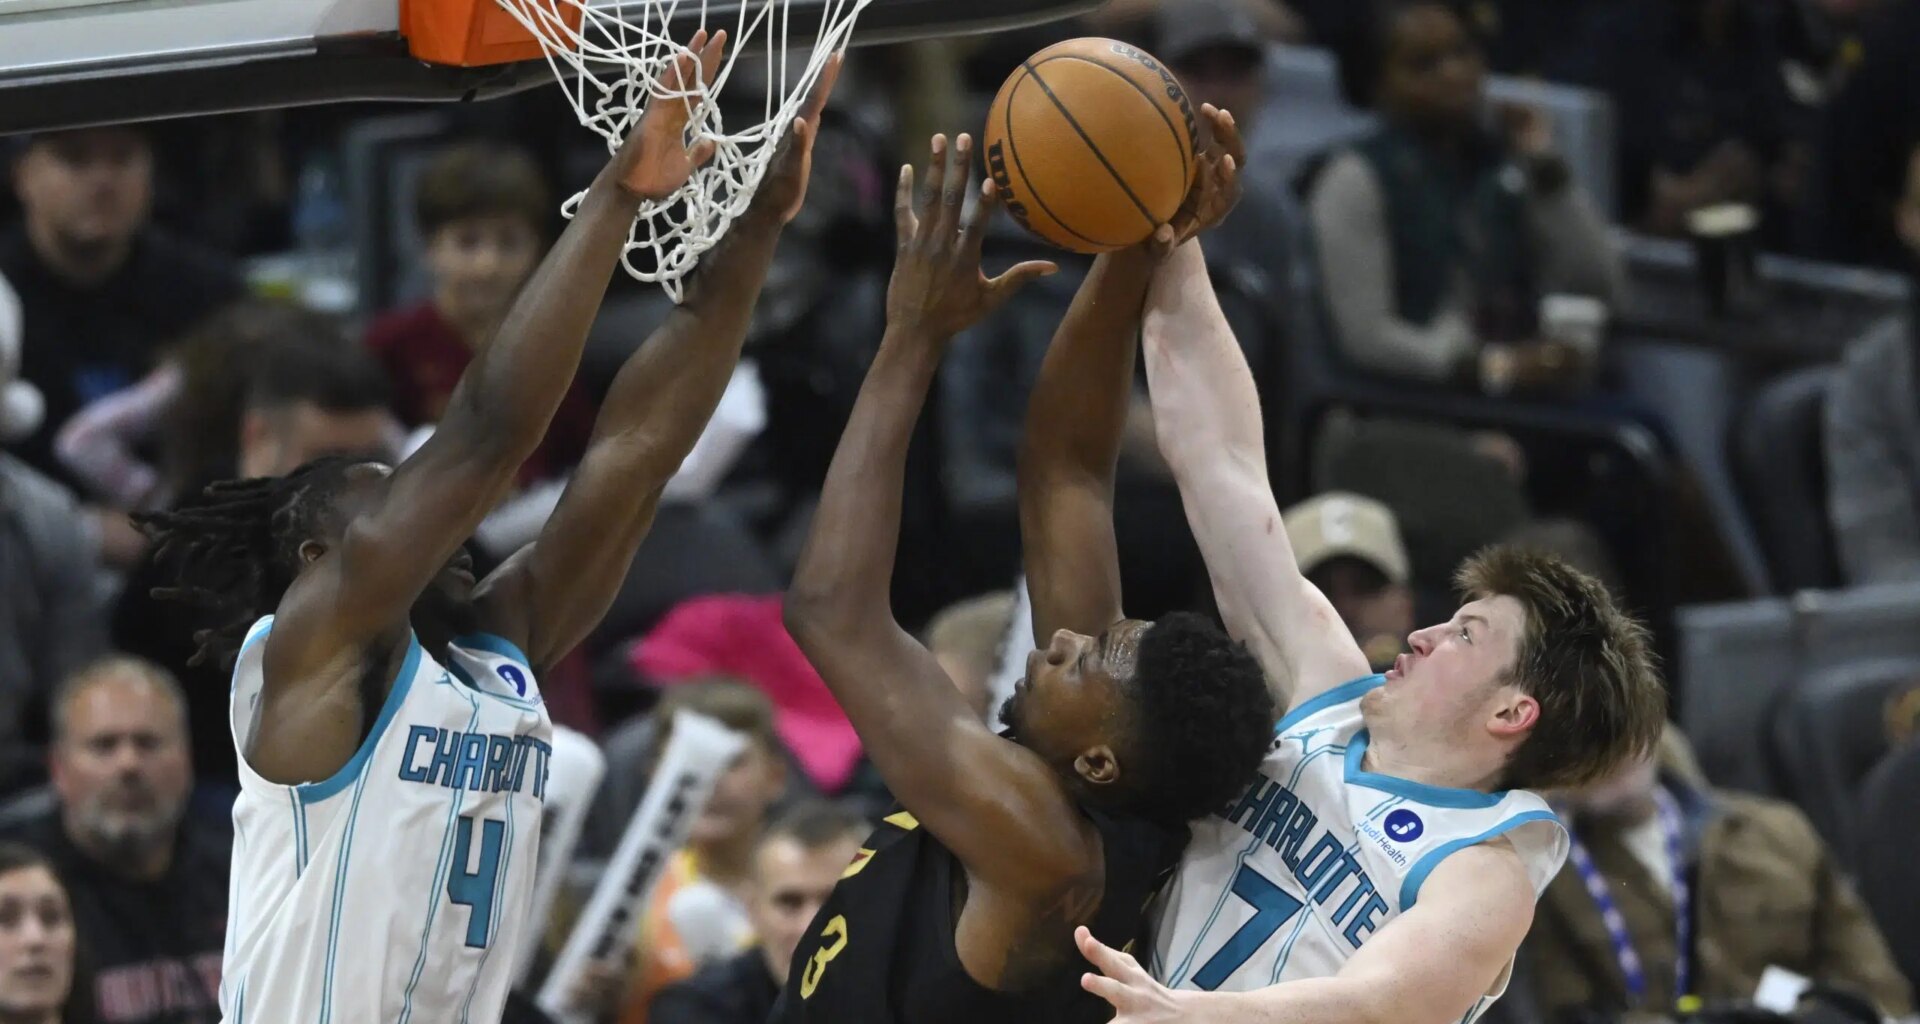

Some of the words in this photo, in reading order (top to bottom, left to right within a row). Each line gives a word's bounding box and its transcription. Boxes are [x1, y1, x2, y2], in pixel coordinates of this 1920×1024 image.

[447, 815, 505, 949] 4
[1214, 773, 1389, 950] HARLOTTE
[1358, 820, 1382, 840] Judi
[1377, 837, 1406, 867] Health
[800, 914, 848, 1000] 3
[1191, 861, 1305, 992] 7
